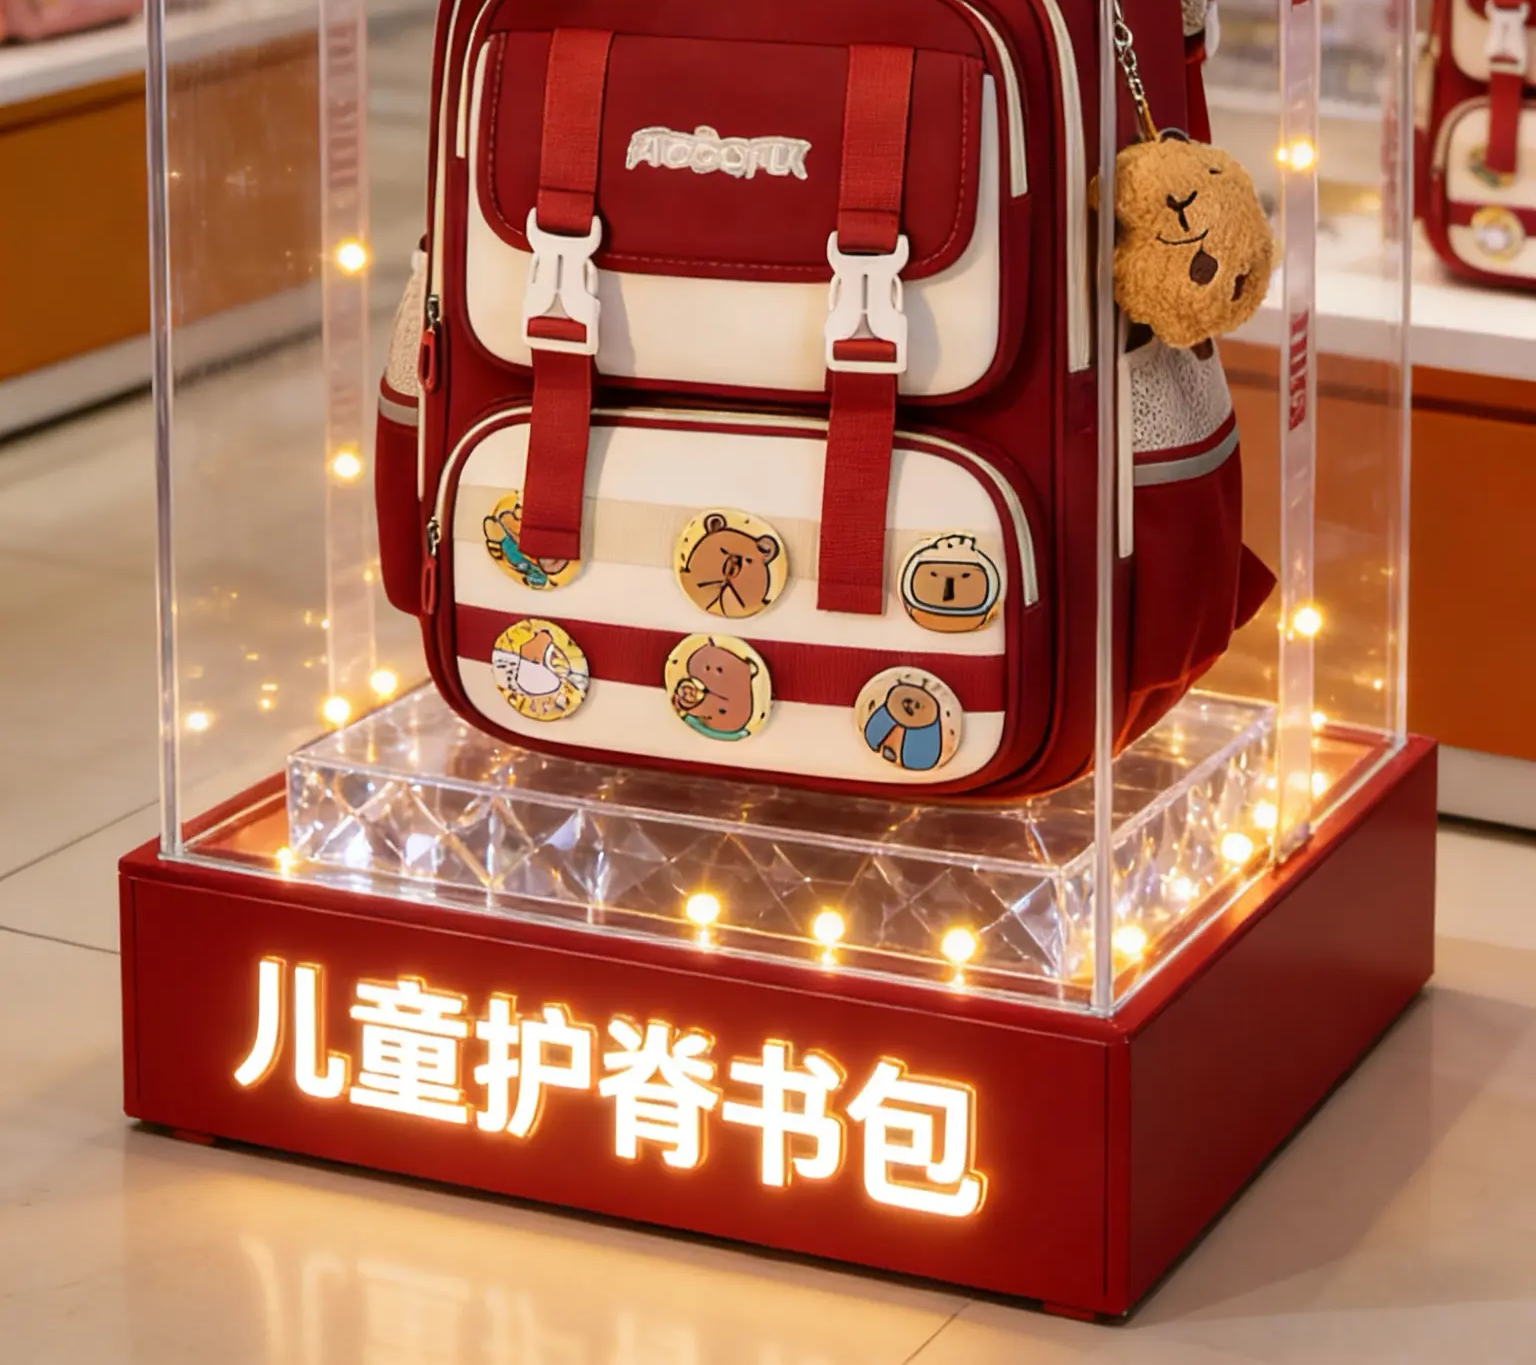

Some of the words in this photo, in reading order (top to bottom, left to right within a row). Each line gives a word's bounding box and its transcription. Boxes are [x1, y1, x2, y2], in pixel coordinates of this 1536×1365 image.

[233, 956, 989, 1218] 儿童护脊书包
